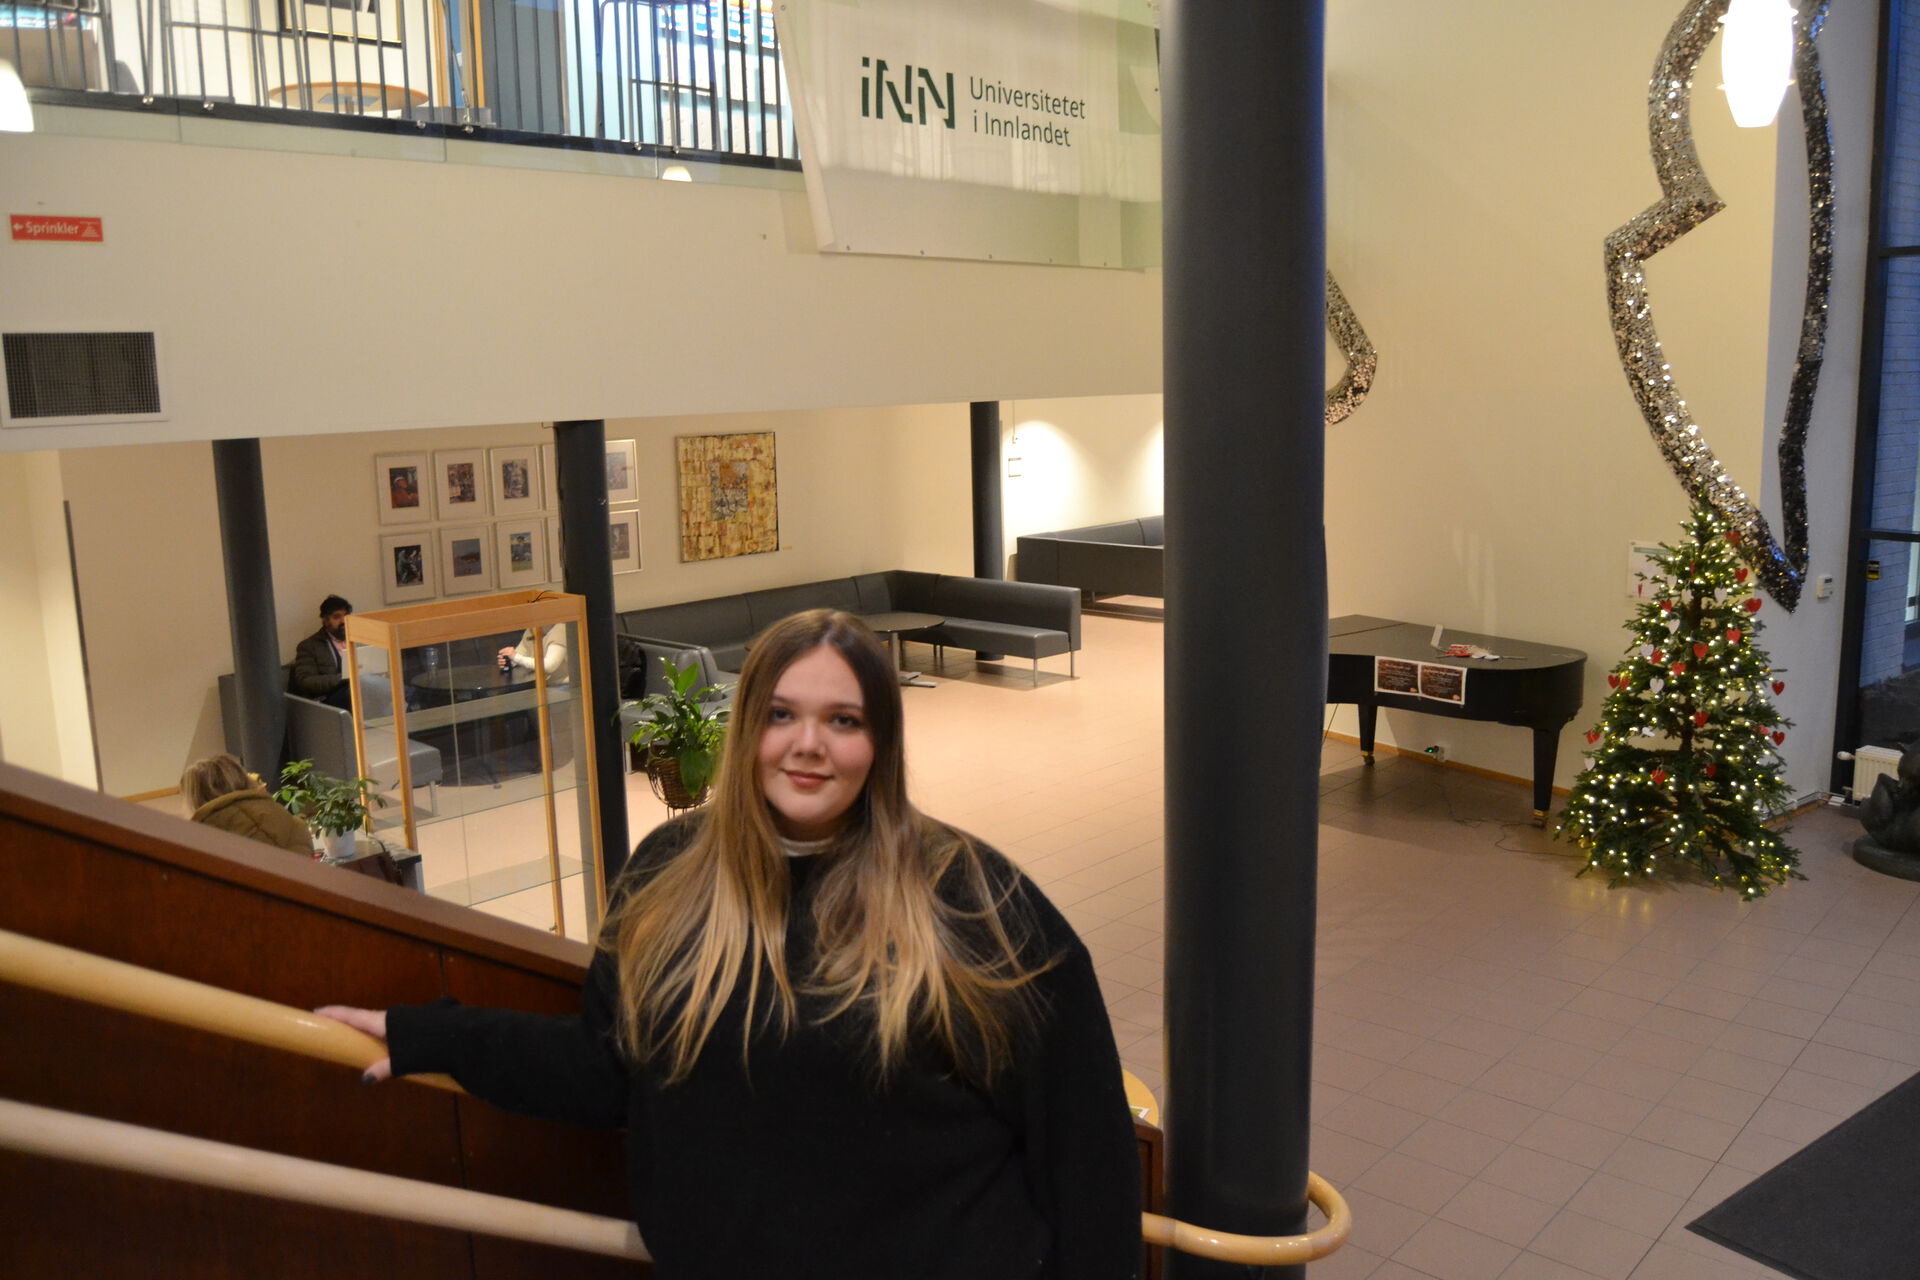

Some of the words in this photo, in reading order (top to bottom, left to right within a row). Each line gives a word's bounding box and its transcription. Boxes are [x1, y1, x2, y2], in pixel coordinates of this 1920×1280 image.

[970, 76, 1086, 120] Universitetet
[973, 109, 978, 133] i
[984, 111, 1071, 147] Innlandet
[25, 221, 79, 236] Sprinkler
